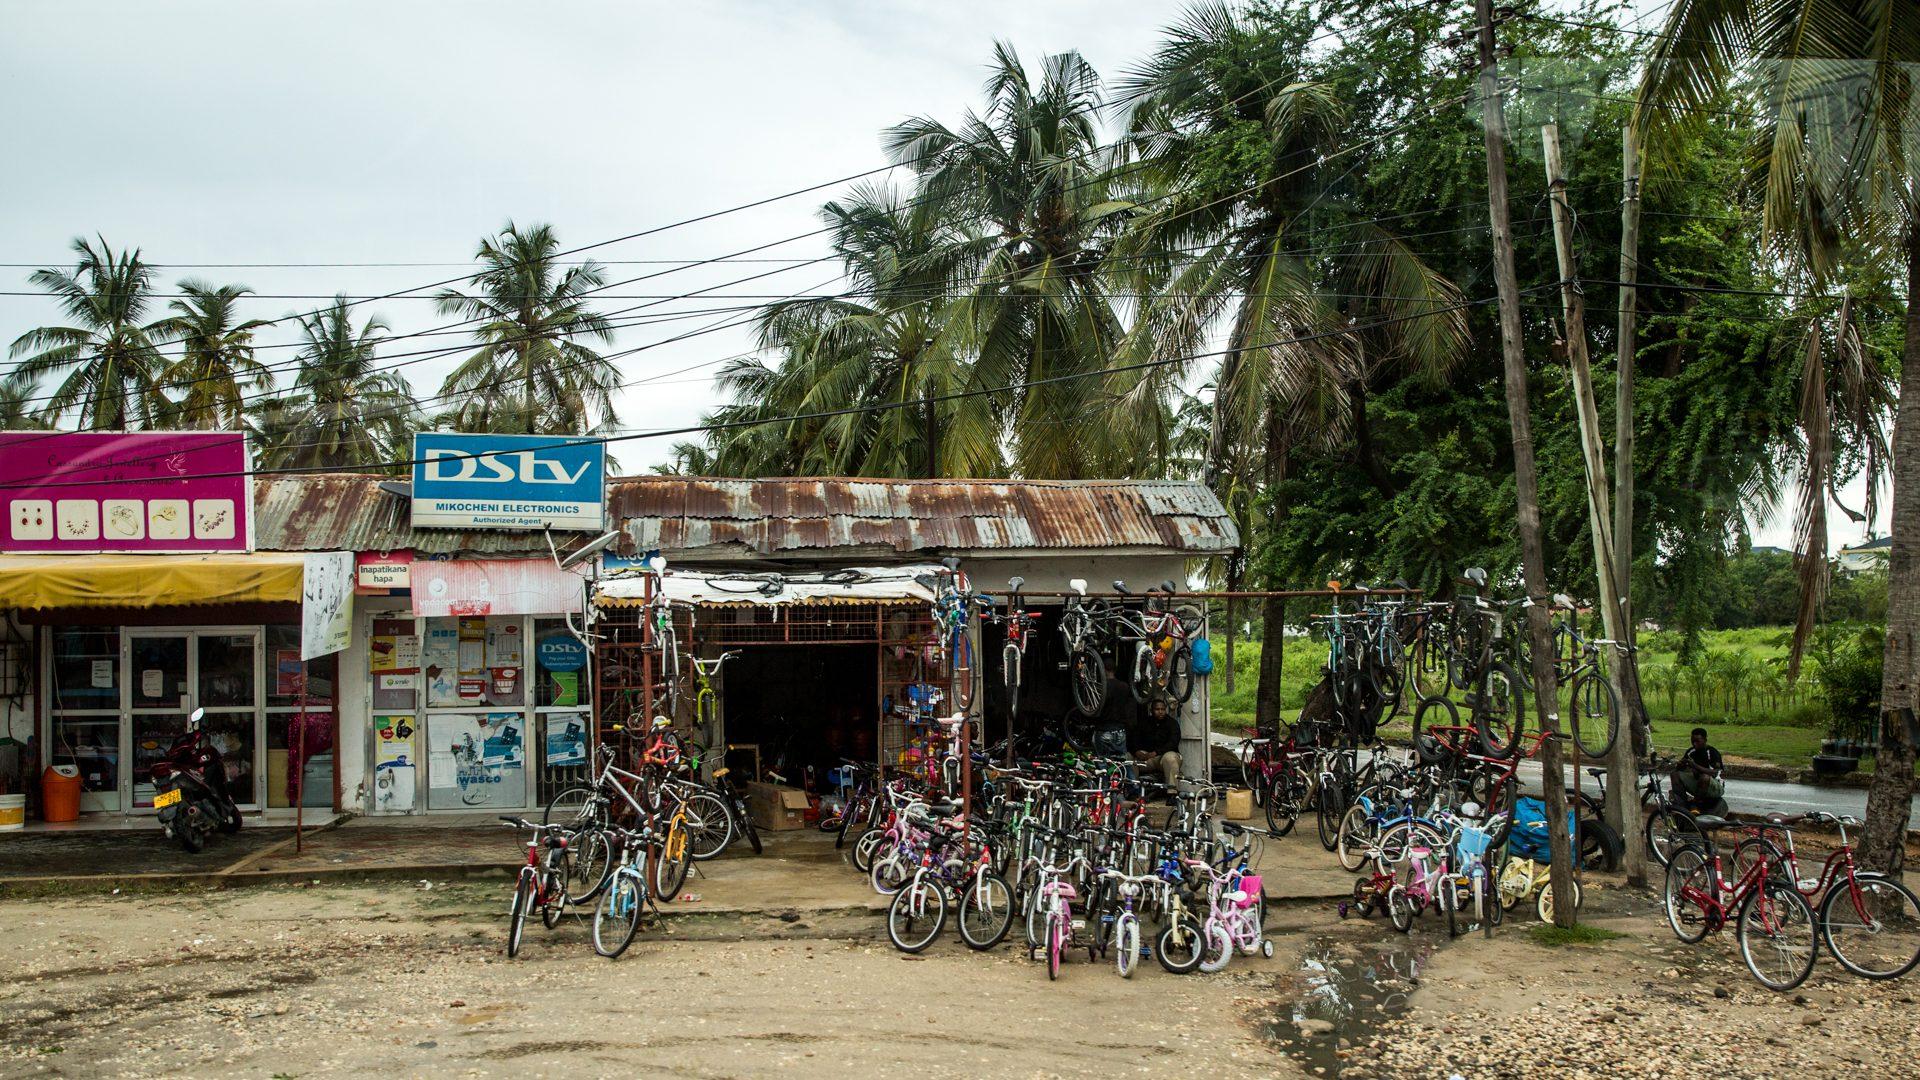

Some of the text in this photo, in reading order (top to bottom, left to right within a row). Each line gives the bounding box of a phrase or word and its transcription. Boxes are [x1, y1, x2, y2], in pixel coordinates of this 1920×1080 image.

[425, 449, 592, 485] DStv
[436, 502, 580, 514] MIKOCHENI ELECTRONICS
[473, 517, 542, 526] Authorized Agent
[360, 565, 407, 575] Inapatikana
[373, 575, 394, 584] hapa
[541, 643, 584, 653] DStv
[457, 776, 502, 784] wasco
